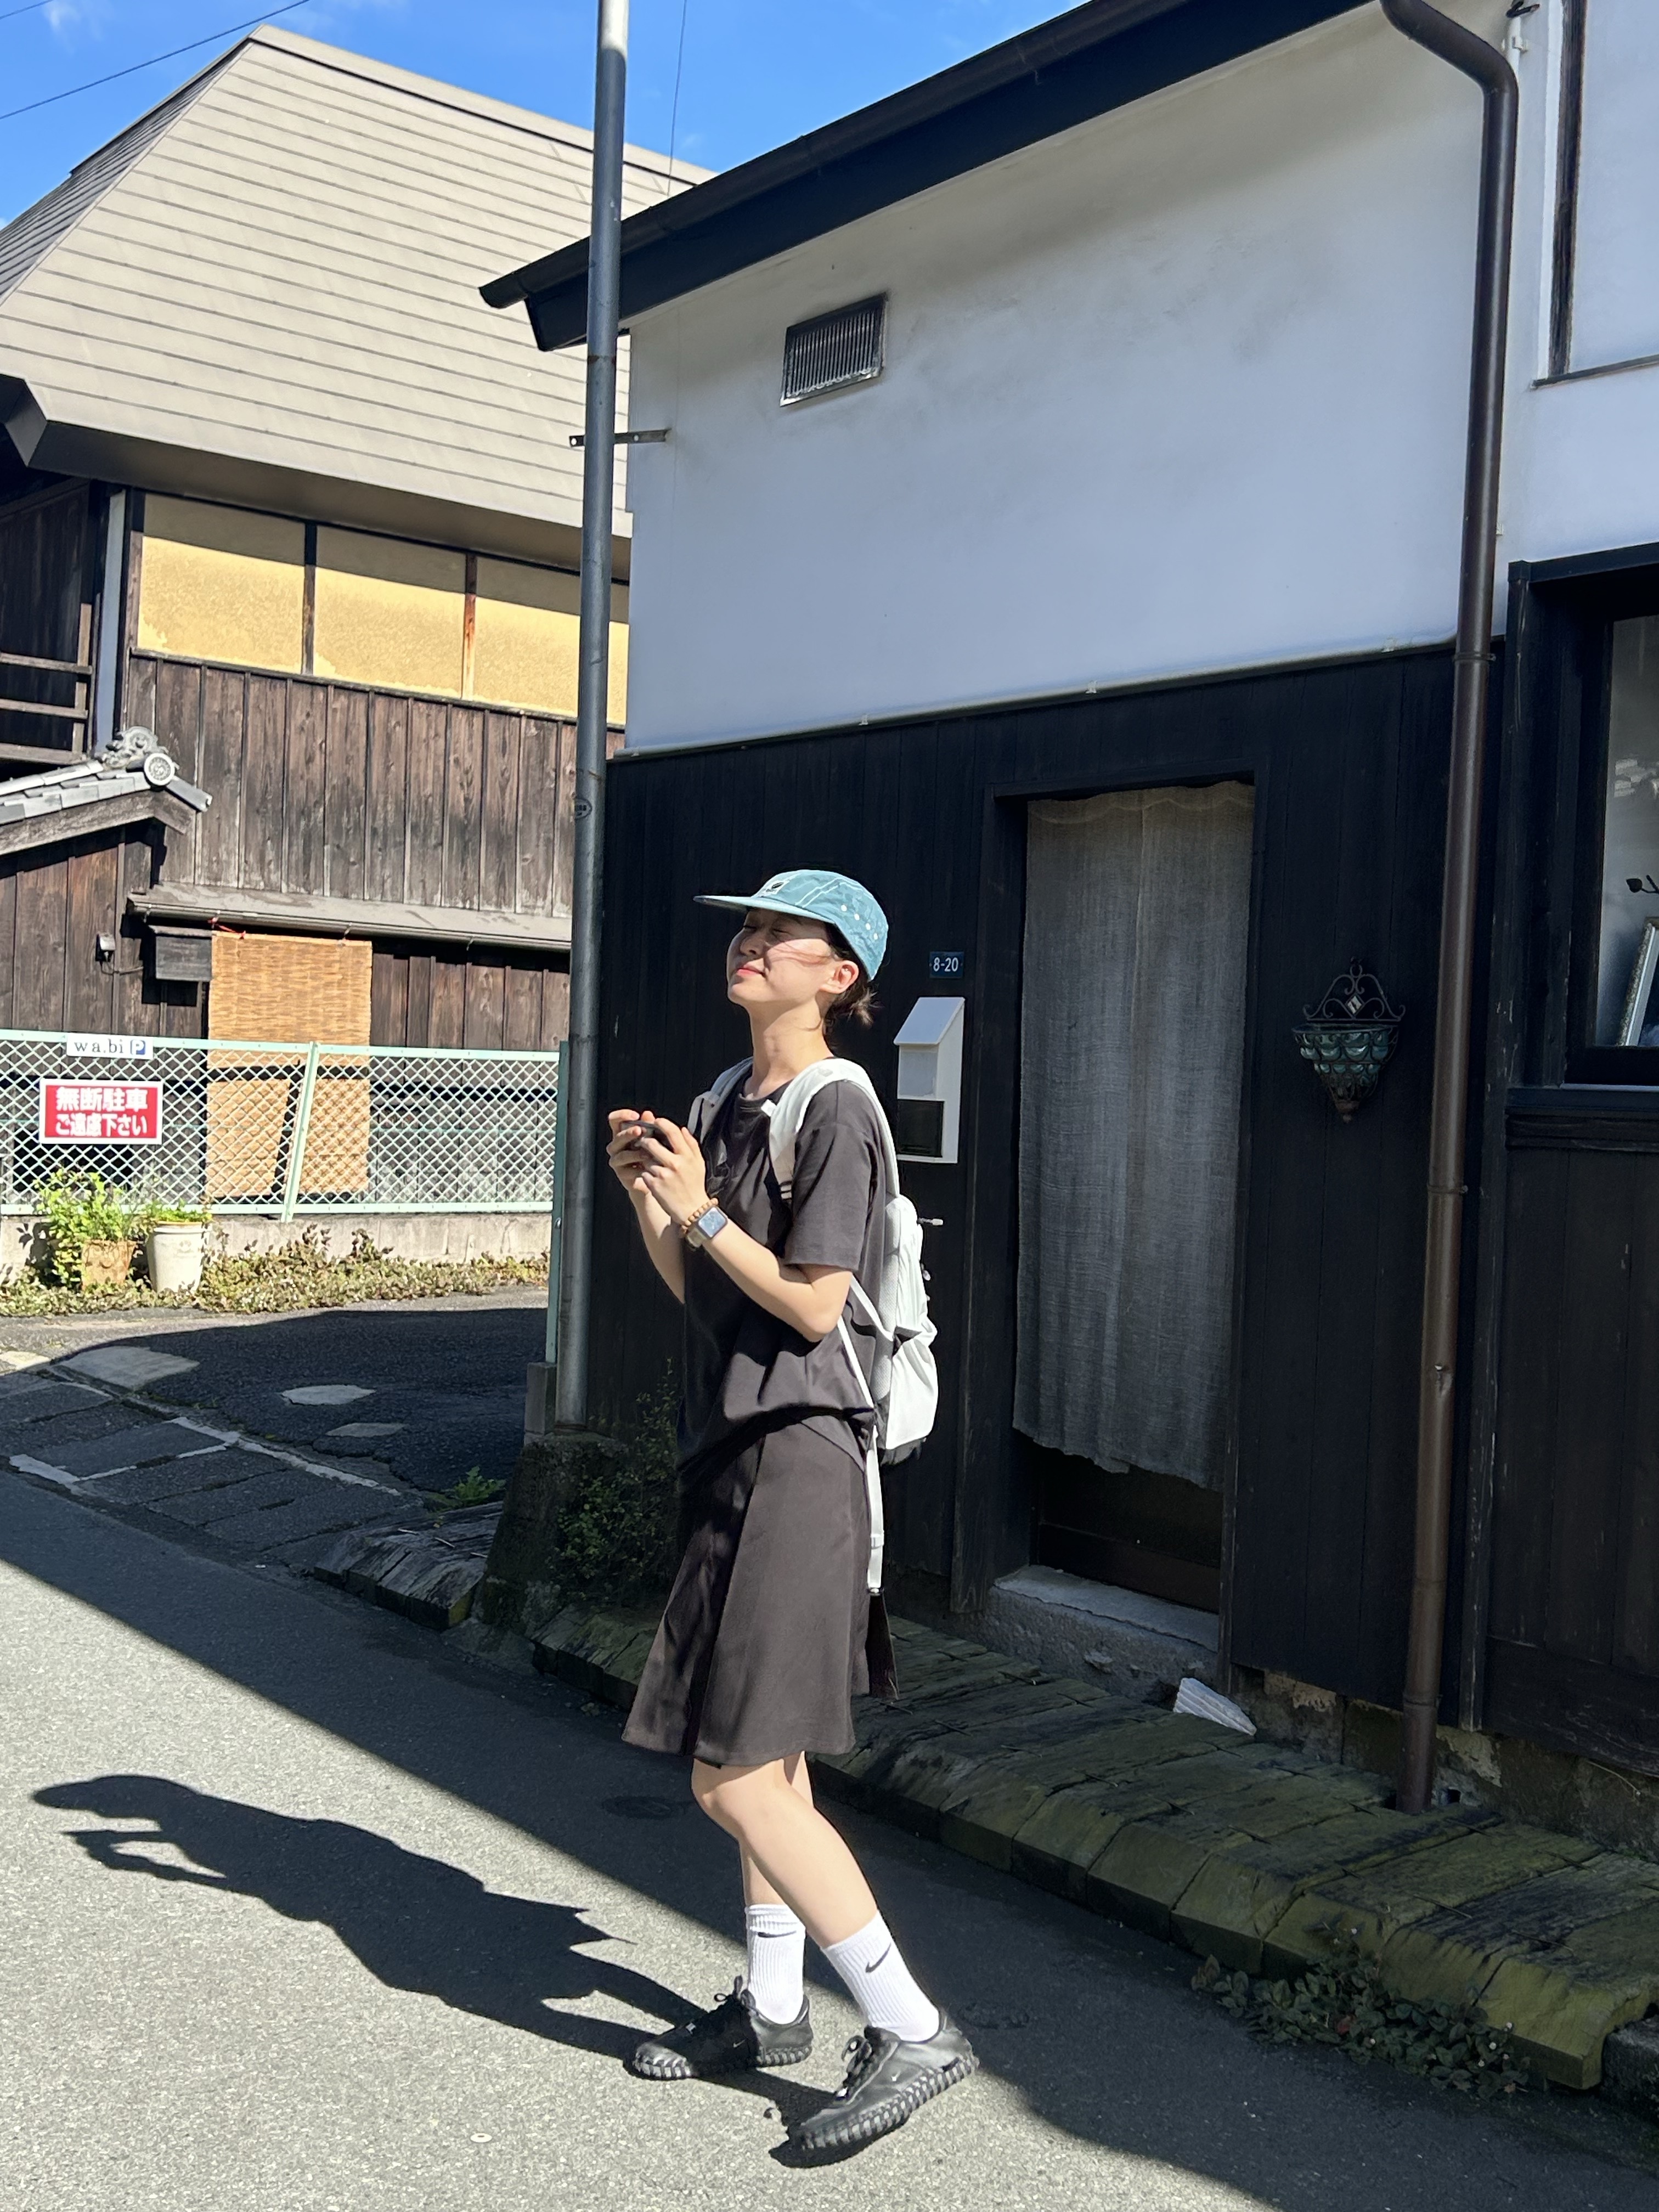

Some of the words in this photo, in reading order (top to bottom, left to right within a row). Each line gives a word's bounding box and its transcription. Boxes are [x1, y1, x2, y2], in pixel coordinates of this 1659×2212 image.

[933, 957, 958, 972] 8-20
[131, 1039, 145, 1055] P
[56, 1086, 148, 1112] 無断駐車
[55, 1113, 148, 1137] ご遠慮下さい
